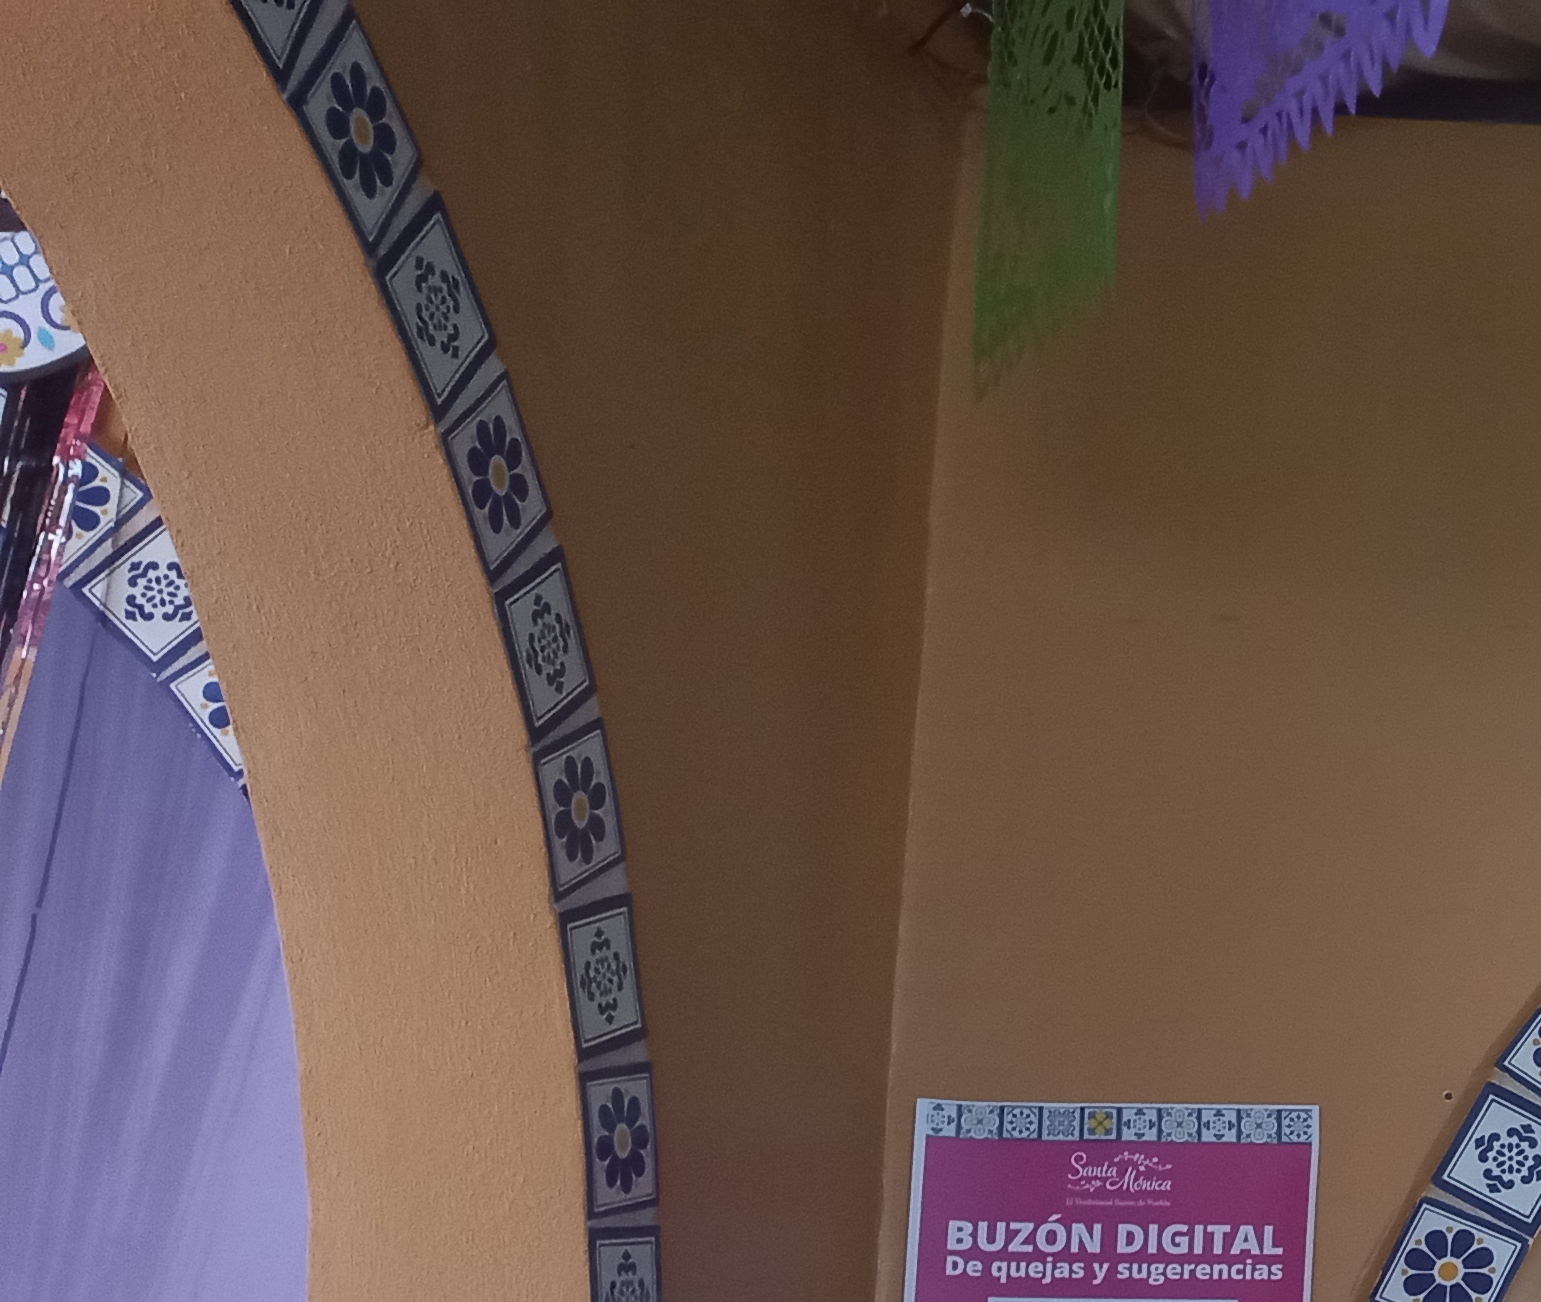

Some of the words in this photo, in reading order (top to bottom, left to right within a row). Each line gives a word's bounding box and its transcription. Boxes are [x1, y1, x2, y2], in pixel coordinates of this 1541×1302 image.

[1067, 1151, 1118, 1180] Santa
[1105, 1165, 1172, 1194] Mónica
[947, 1214, 1102, 1254] BUZÓN
[1117, 1223, 1284, 1255] DIGITAL
[945, 1255, 982, 1277] De
[991, 1256, 1085, 1286] quejas
[1093, 1263, 1109, 1285] y
[1117, 1259, 1283, 1286] sugerencias
